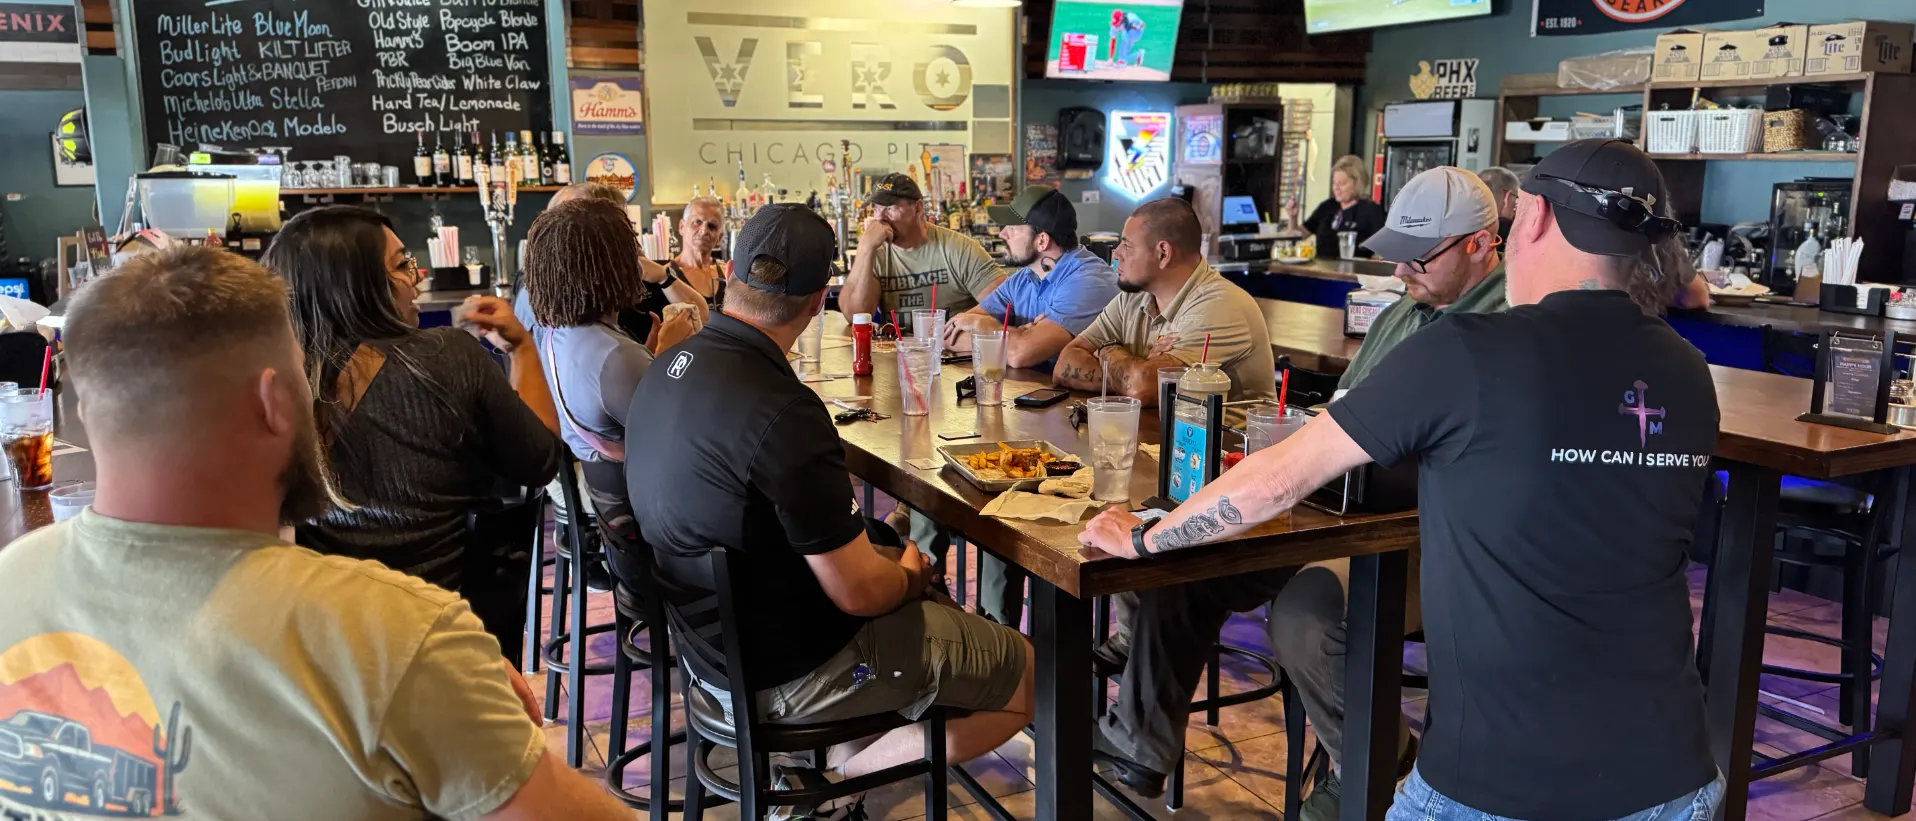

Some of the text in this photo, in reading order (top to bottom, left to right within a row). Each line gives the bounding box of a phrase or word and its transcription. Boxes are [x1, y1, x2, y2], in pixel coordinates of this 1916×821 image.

[157, 11, 243, 37] Miller Lite
[253, 9, 333, 38] Blue Moon
[369, 11, 431, 35] Old Style
[498, 10, 539, 28] Blonde
[1560, 17, 1577, 28] 1920
[373, 29, 424, 49] Hamm's
[445, 32, 529, 52] Boom IPA
[160, 39, 242, 67] Bud Light
[257, 39, 352, 60] KILT LIFTER
[376, 52, 410, 69] PBR
[446, 54, 531, 74] Big Blue Van
[161, 68, 212, 89] Coors
[213, 64, 249, 92] Light
[262, 60, 330, 82] BANQUET
[693, 35, 973, 111] VERO
[1436, 60, 1477, 84] PHX
[462, 74, 541, 92] White Claw
[270, 87, 325, 110] Stella
[372, 92, 412, 111] Hard
[580, 101, 637, 119] Hamm's
[284, 113, 347, 137] Modelo
[383, 112, 480, 134] Busch Light
[698, 142, 863, 165] CHICAGO
[901, 294, 924, 307] THE
[1624, 390, 1635, 404] G
[1649, 421, 1663, 435] M
[1551, 448, 1710, 467] HOW CAN I SERVE YOU
